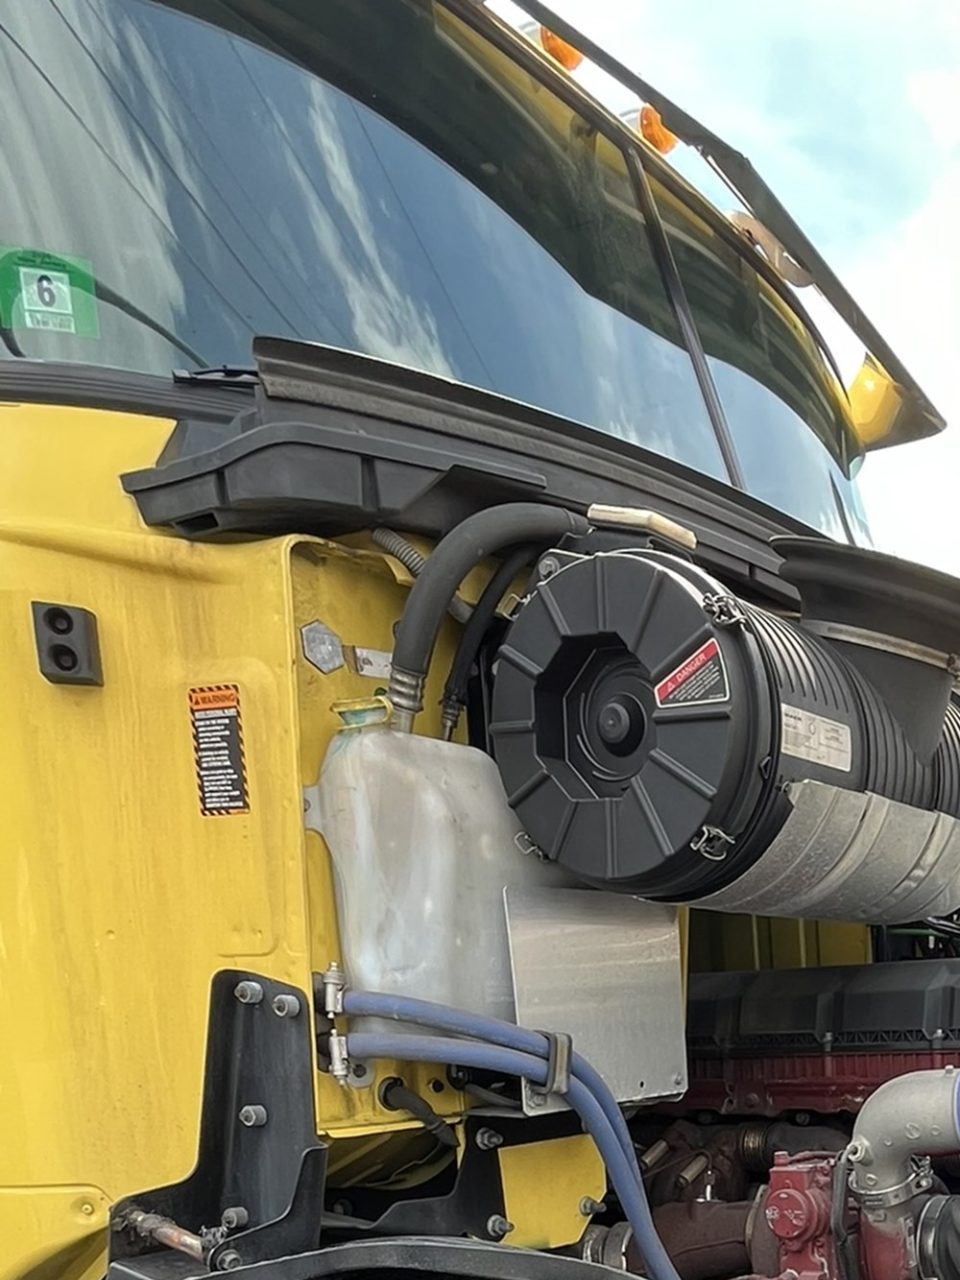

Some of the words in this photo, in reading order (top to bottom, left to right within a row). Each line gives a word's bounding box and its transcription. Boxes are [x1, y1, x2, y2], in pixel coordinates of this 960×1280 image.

[37, 274, 56, 307] 6
[676, 652, 706, 682] DANGER
[200, 692, 235, 704] WARNING
